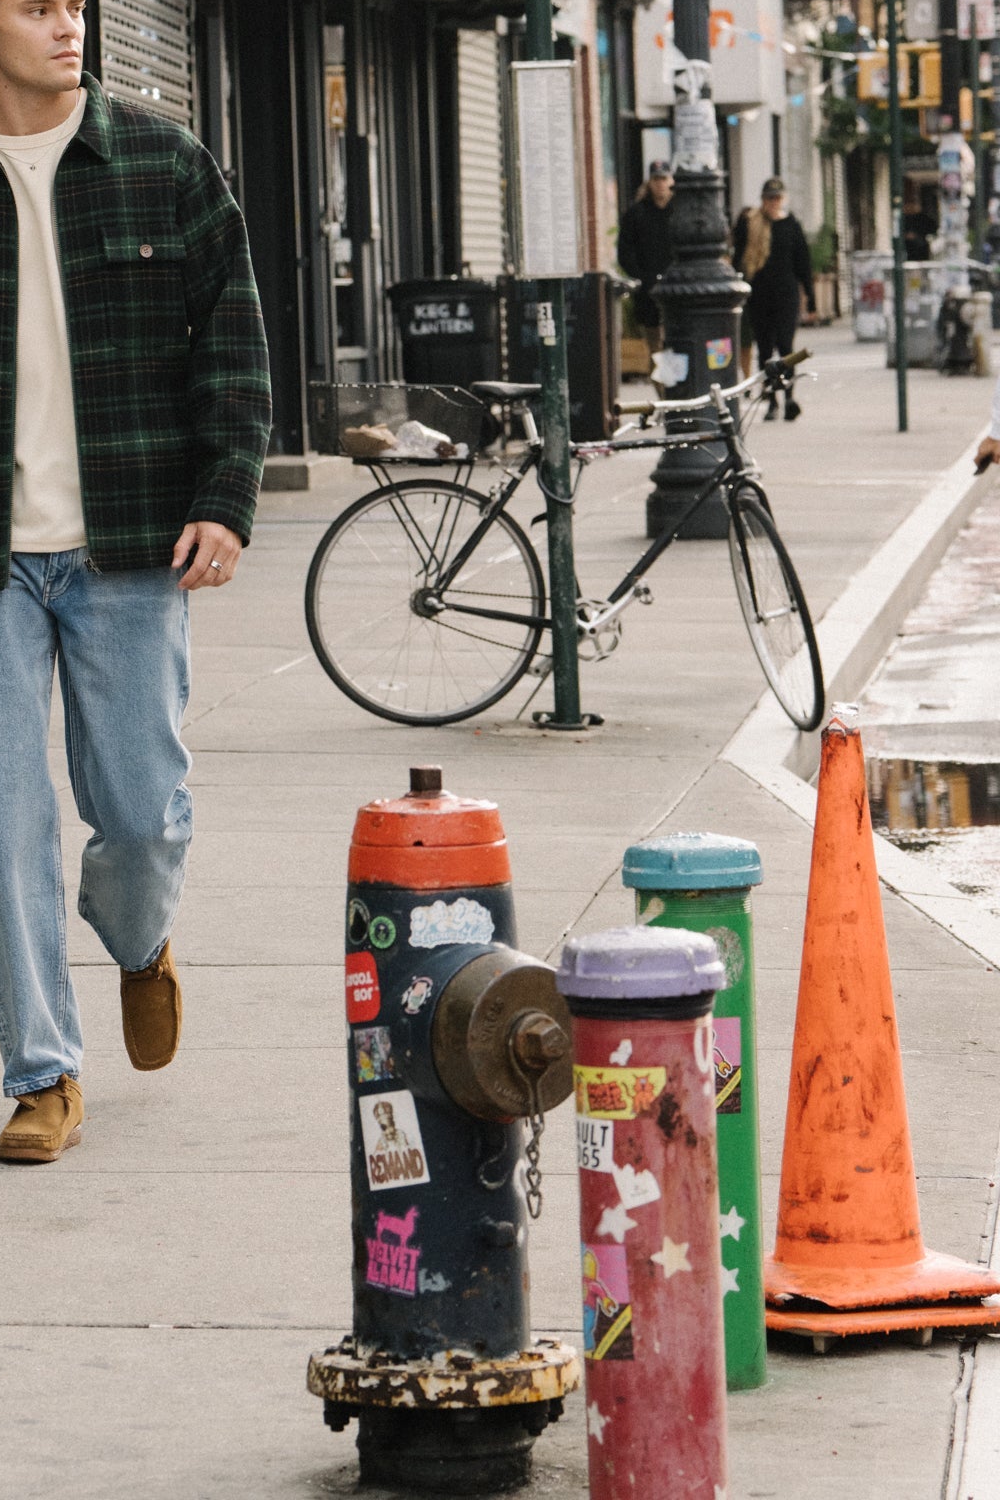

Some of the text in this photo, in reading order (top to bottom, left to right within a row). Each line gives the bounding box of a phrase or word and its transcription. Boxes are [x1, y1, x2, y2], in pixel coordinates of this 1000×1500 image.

[414, 302, 450, 318] KEG
[409, 318, 474, 335] LANTERN
[354, 987, 373, 1002] JOB
[366, 1239, 420, 1271] VELVET
